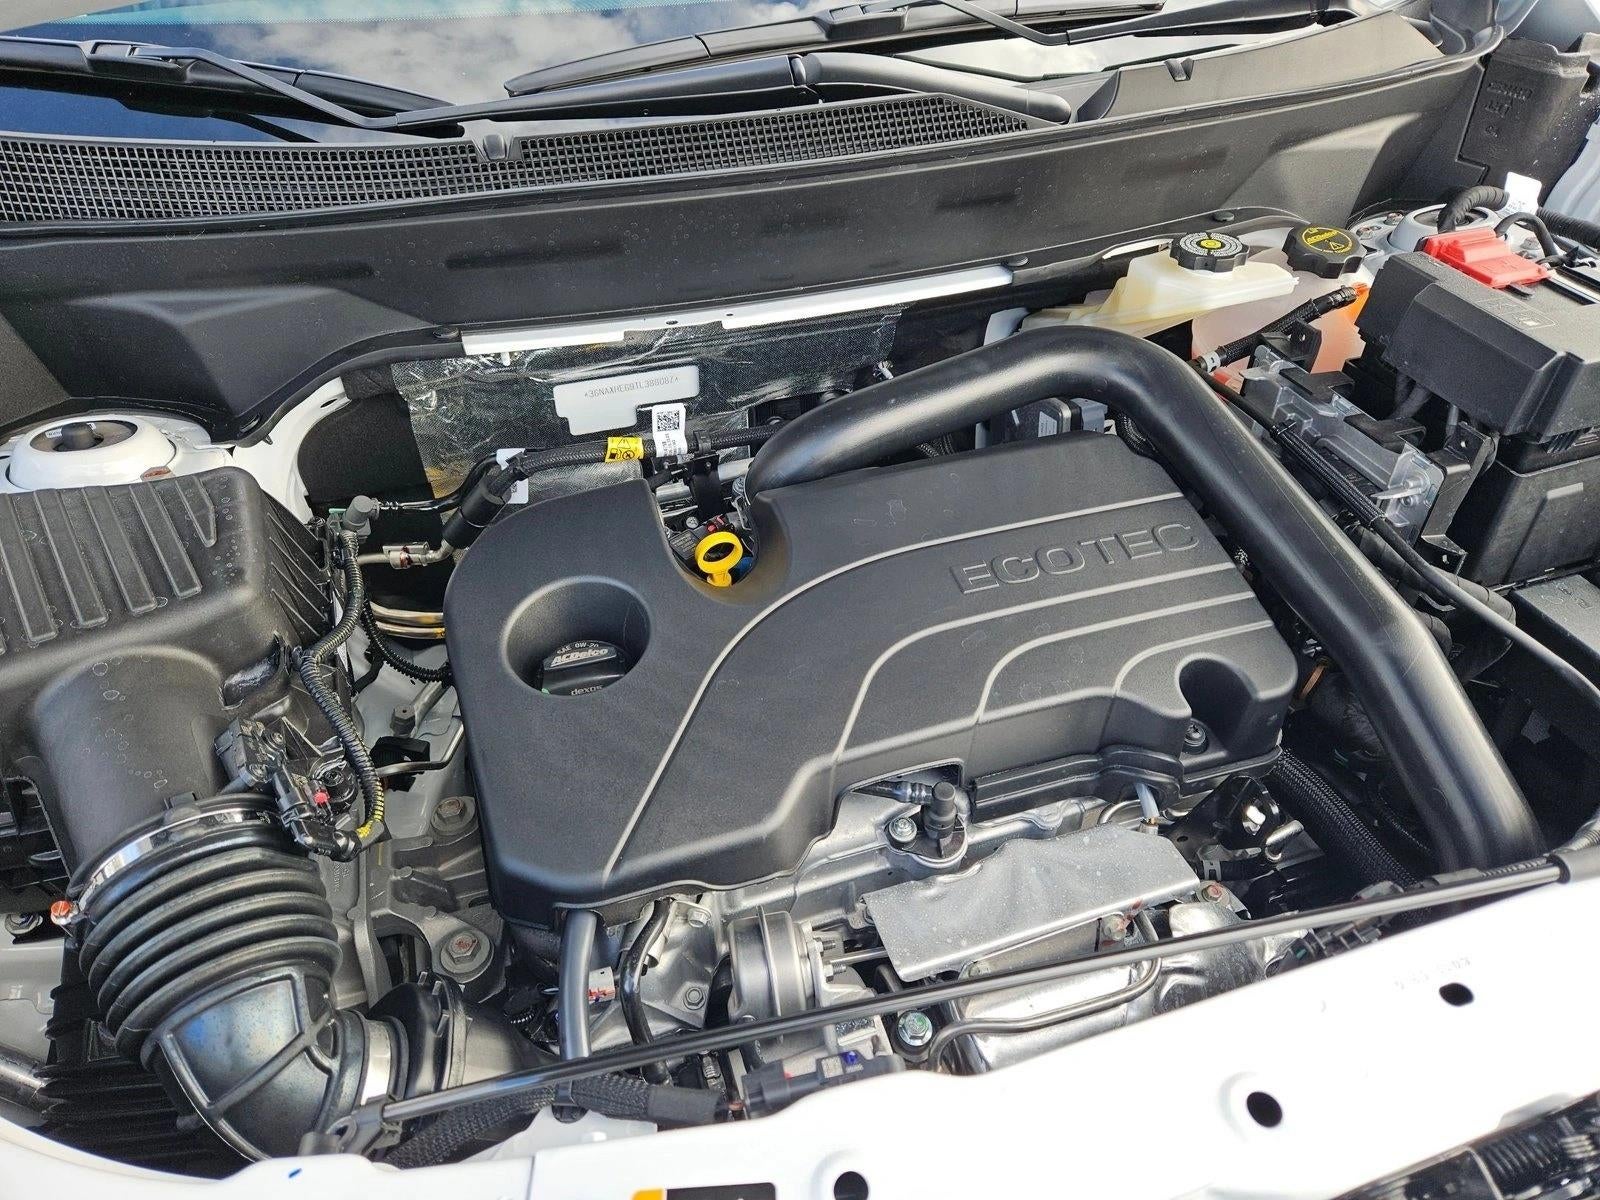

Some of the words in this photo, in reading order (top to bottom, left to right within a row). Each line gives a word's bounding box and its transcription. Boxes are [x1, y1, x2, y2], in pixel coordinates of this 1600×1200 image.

[950, 523, 1200, 595] ECOTEC
[550, 648, 609, 667] ACDelco
[557, 645, 571, 654] SAE
